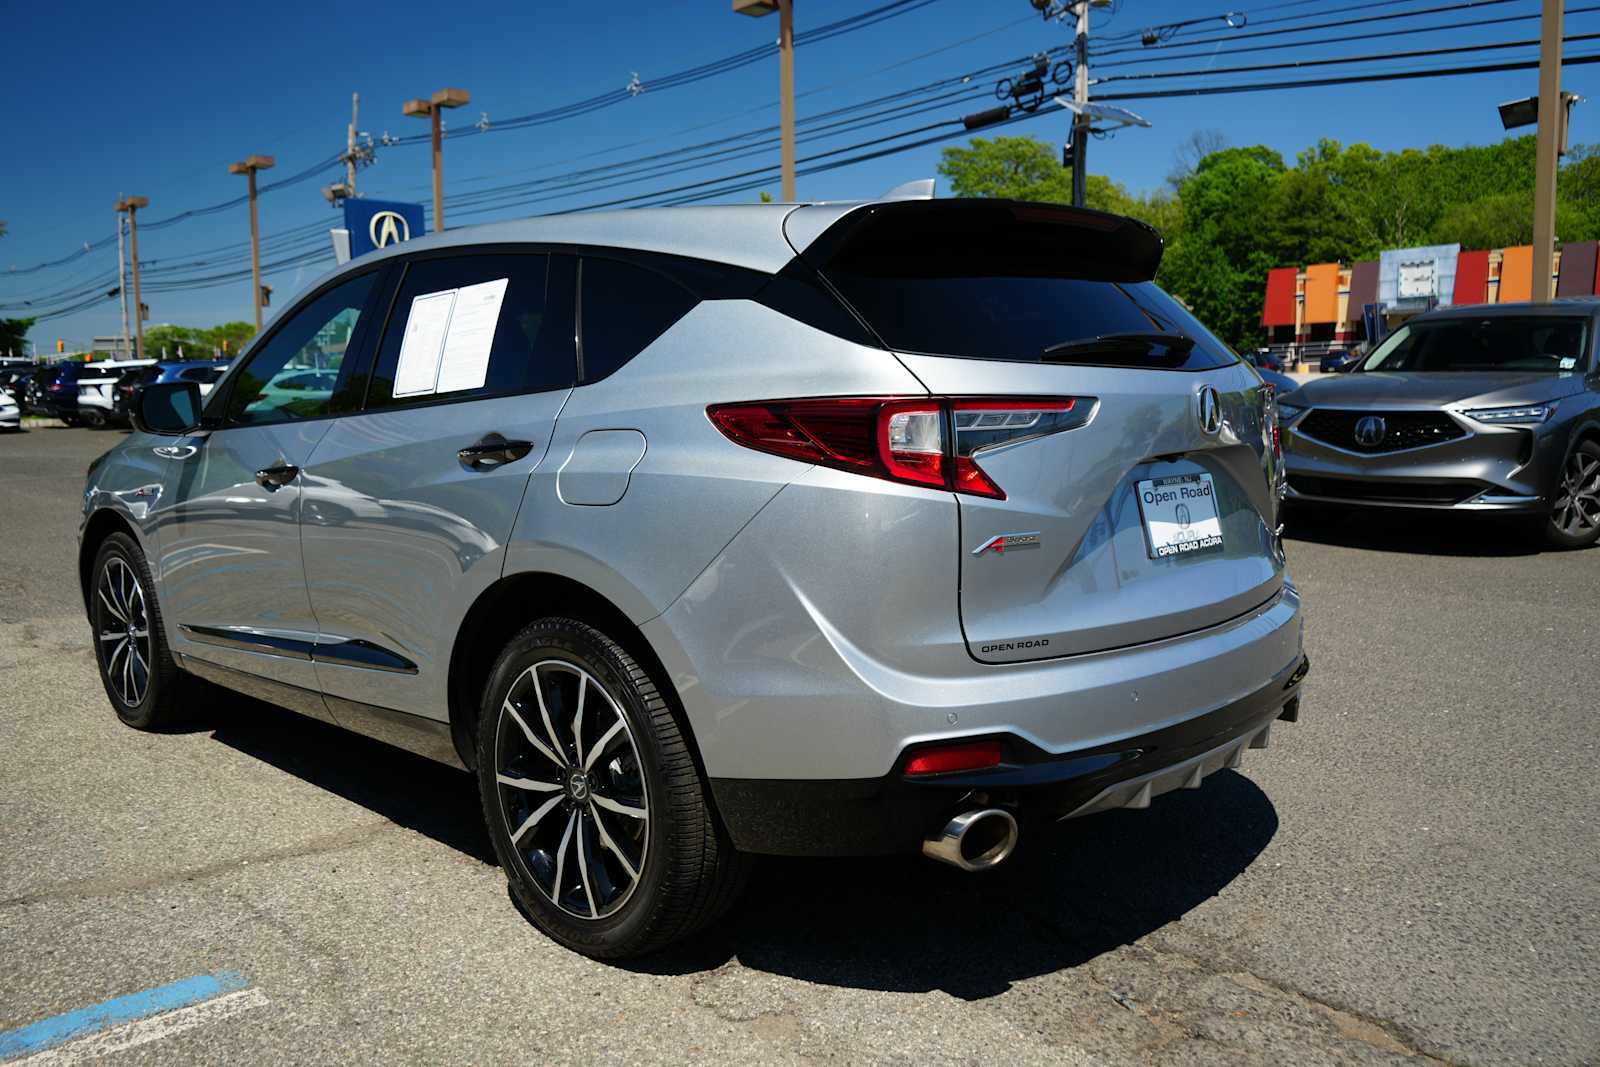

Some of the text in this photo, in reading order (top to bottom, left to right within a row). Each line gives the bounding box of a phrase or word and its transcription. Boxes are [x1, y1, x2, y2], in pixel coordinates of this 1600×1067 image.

[1144, 484, 1210, 506] Open Road
[1158, 537, 1223, 556] OPEN ROAD ACURA
[981, 640, 1049, 652] OPEN ROAD
